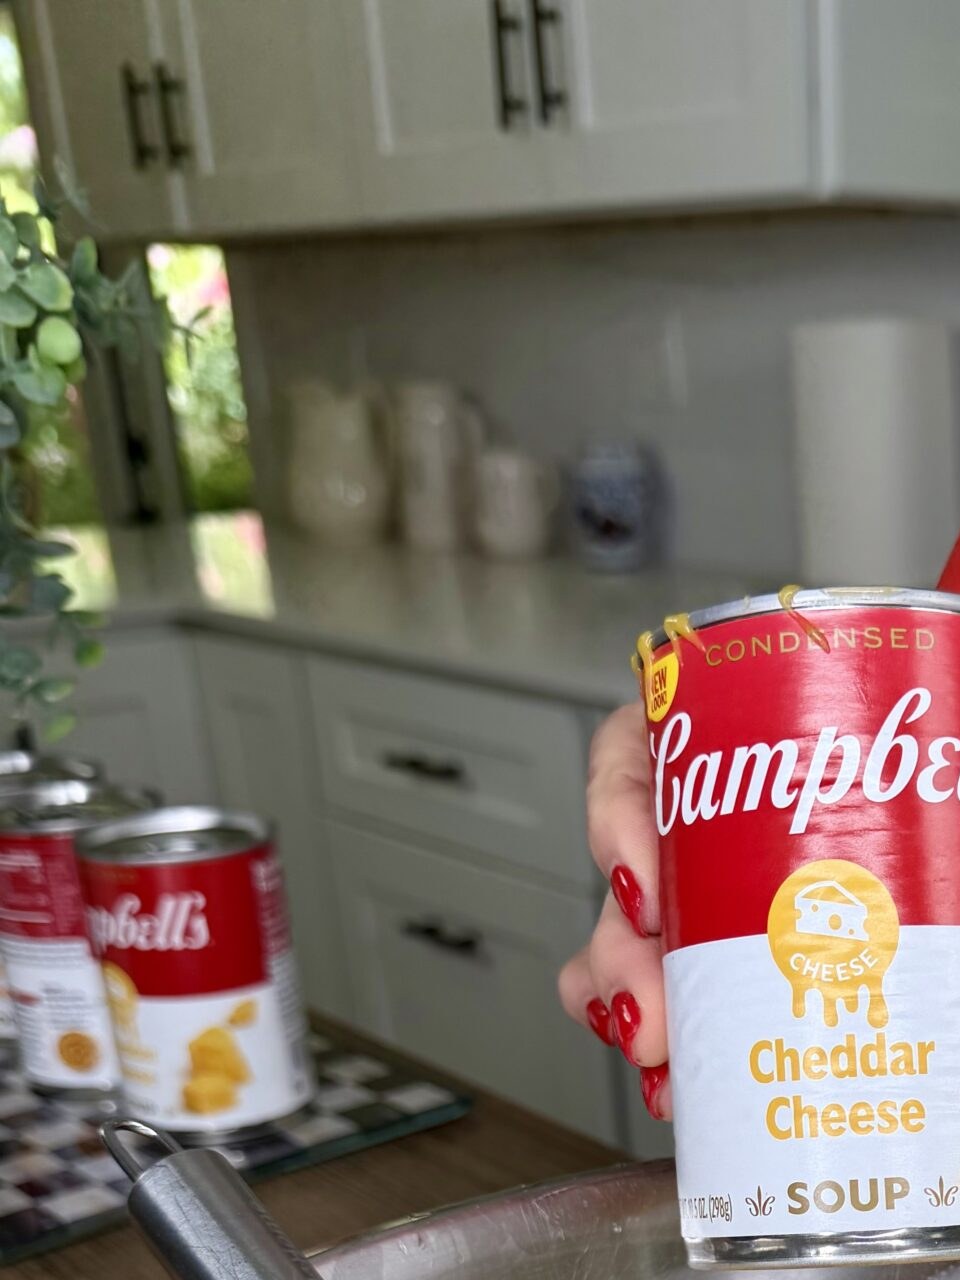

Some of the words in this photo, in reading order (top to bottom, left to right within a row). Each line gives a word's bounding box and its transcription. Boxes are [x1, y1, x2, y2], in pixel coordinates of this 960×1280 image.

[705, 627, 936, 666] CONDENSED
[87, 890, 210, 954] pbell's
[789, 946, 878, 982] CHEESE
[749, 1032, 936, 1084] Cheddar
[765, 1095, 927, 1141] Cheese
[709, 1193, 732, 1222] (298g)
[787, 1176, 911, 1215] SOUP
